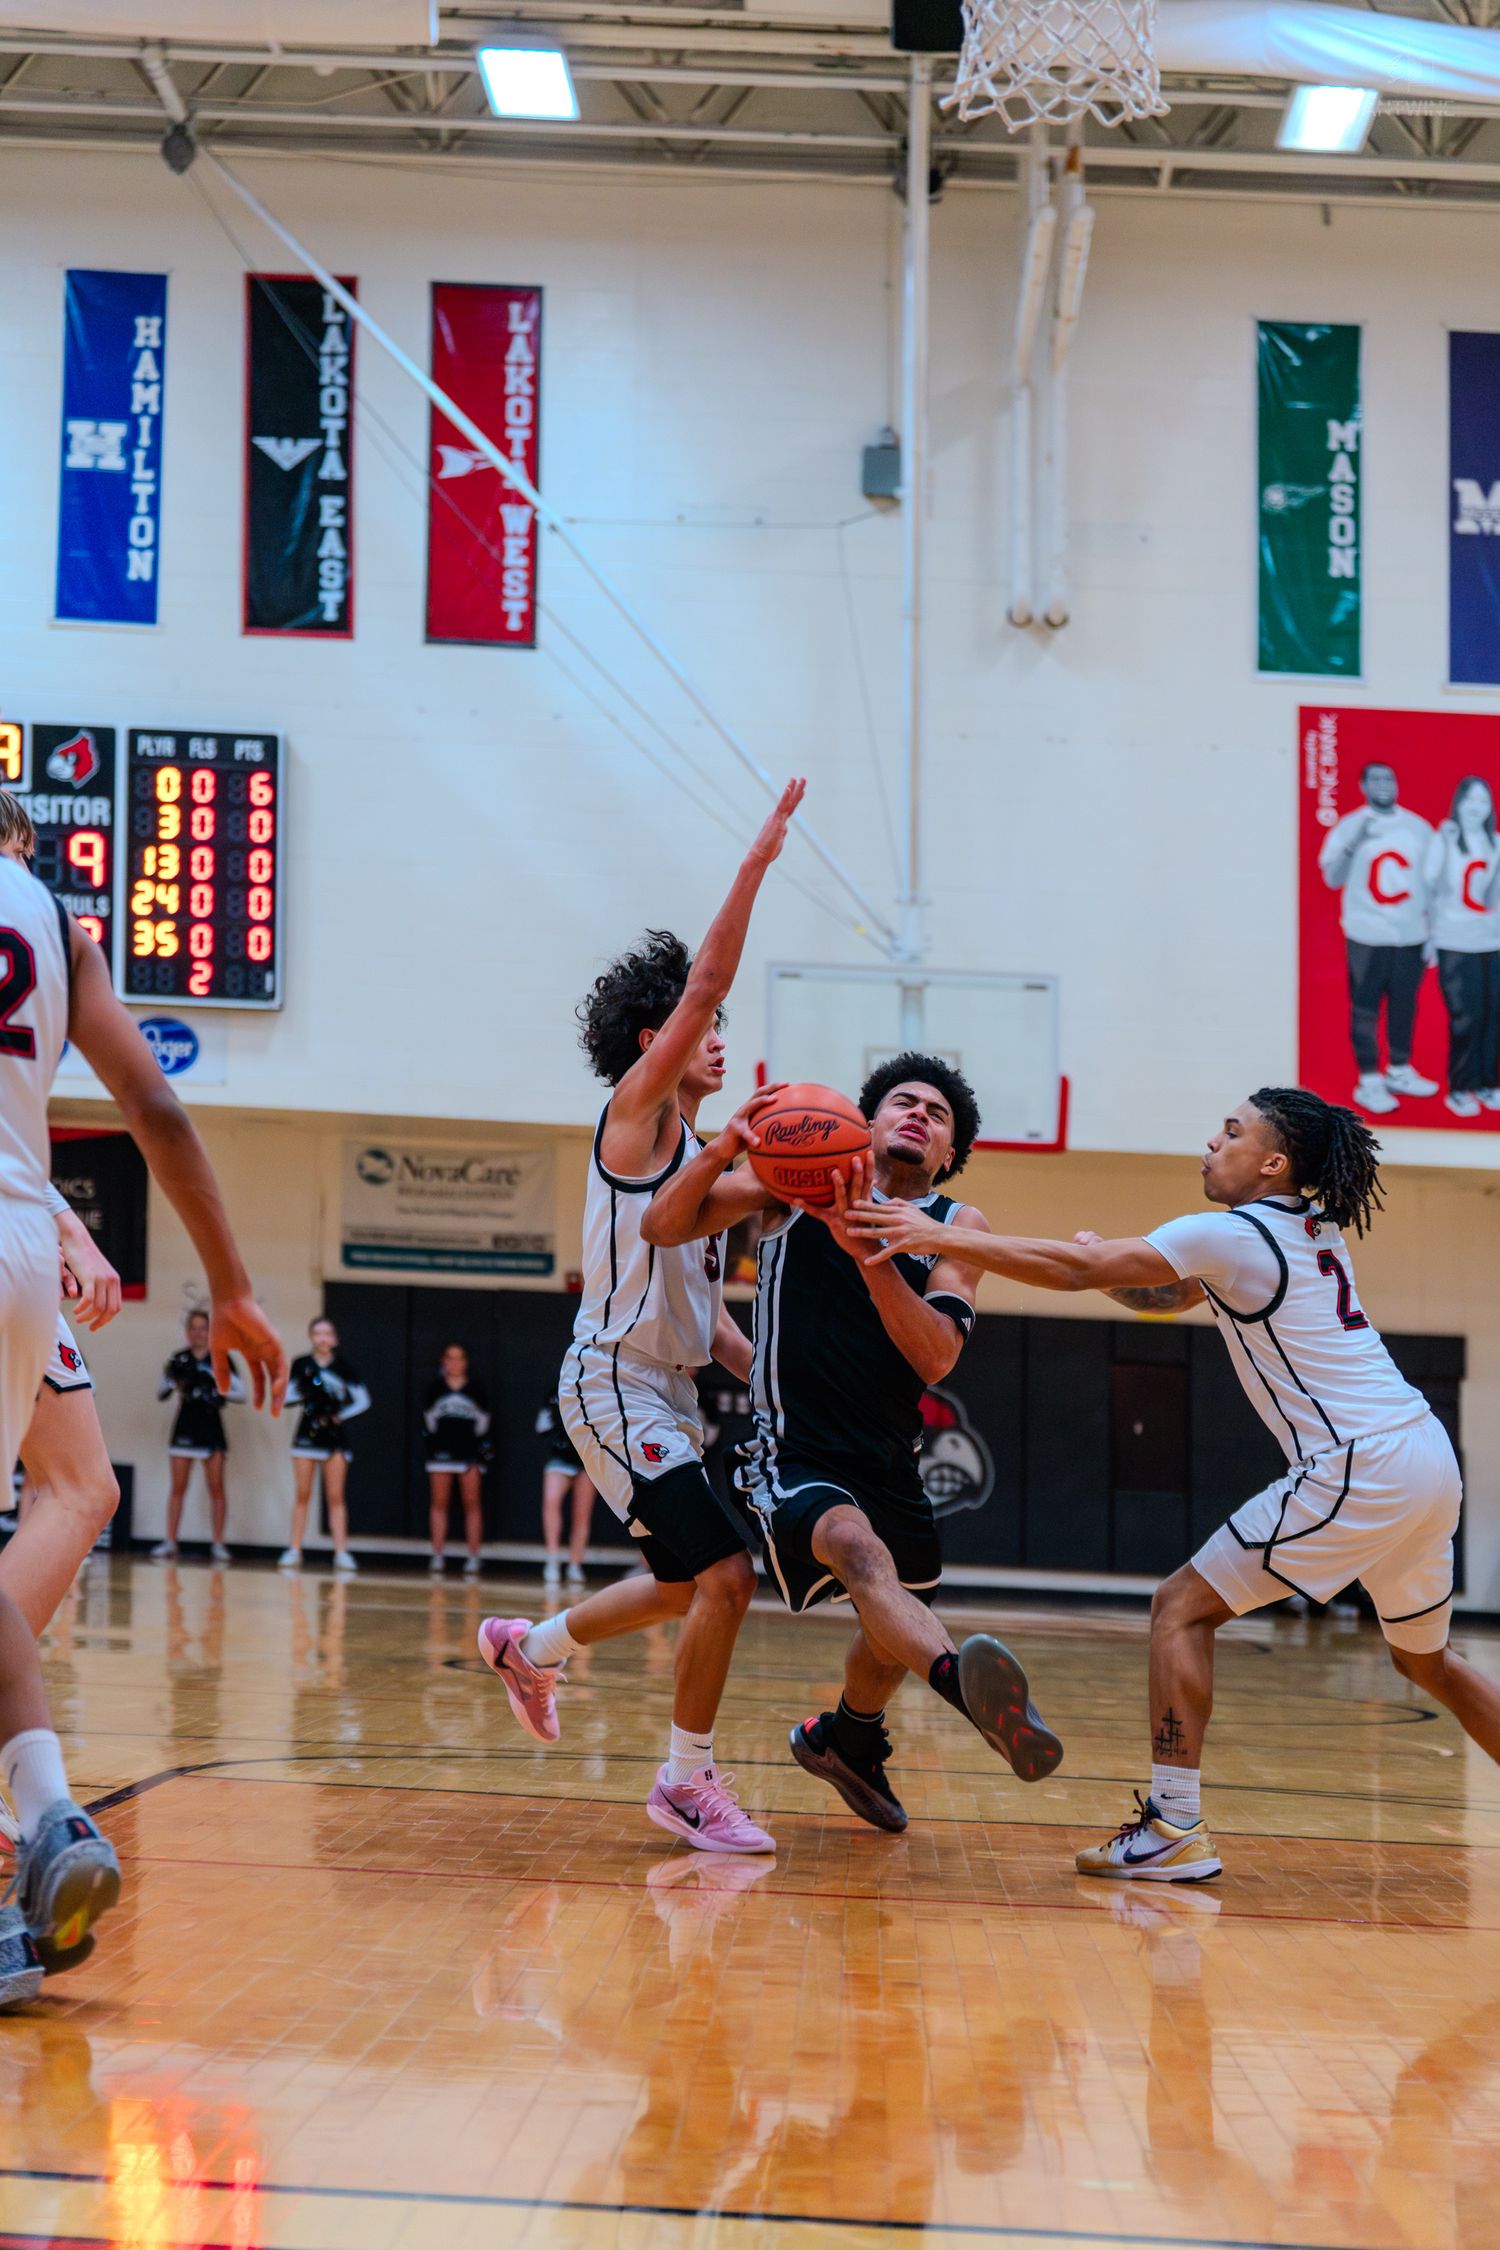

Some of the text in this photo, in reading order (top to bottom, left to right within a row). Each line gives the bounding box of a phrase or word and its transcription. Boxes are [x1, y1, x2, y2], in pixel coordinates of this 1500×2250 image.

[127, 316, 161, 582] HAMILTON
[317, 293, 348, 621] LAKOTA EAST
[499, 302, 535, 630] LAKOTA WEST
[1326, 419, 1358, 578] MASON
[137, 735, 265, 762] PLYR FLS PTS
[156, 766, 274, 807] 0 0 6
[158, 804, 274, 844] 3 0 0
[69, 831, 106, 888] 9
[144, 843, 273, 884] 13 0 0
[1369, 851, 1410, 905] C
[57, 892, 110, 918] OULS
[131, 879, 273, 921] 24 0 0
[133, 919, 179, 957] 35
[189, 922, 214, 958] 0
[247, 925, 272, 961] 0
[188, 959, 214, 996] 2
[765, 1114, 840, 1146] Rawlings
[399, 1156, 522, 1187] NovaCare
[1317, 1249, 1369, 1331] 2
